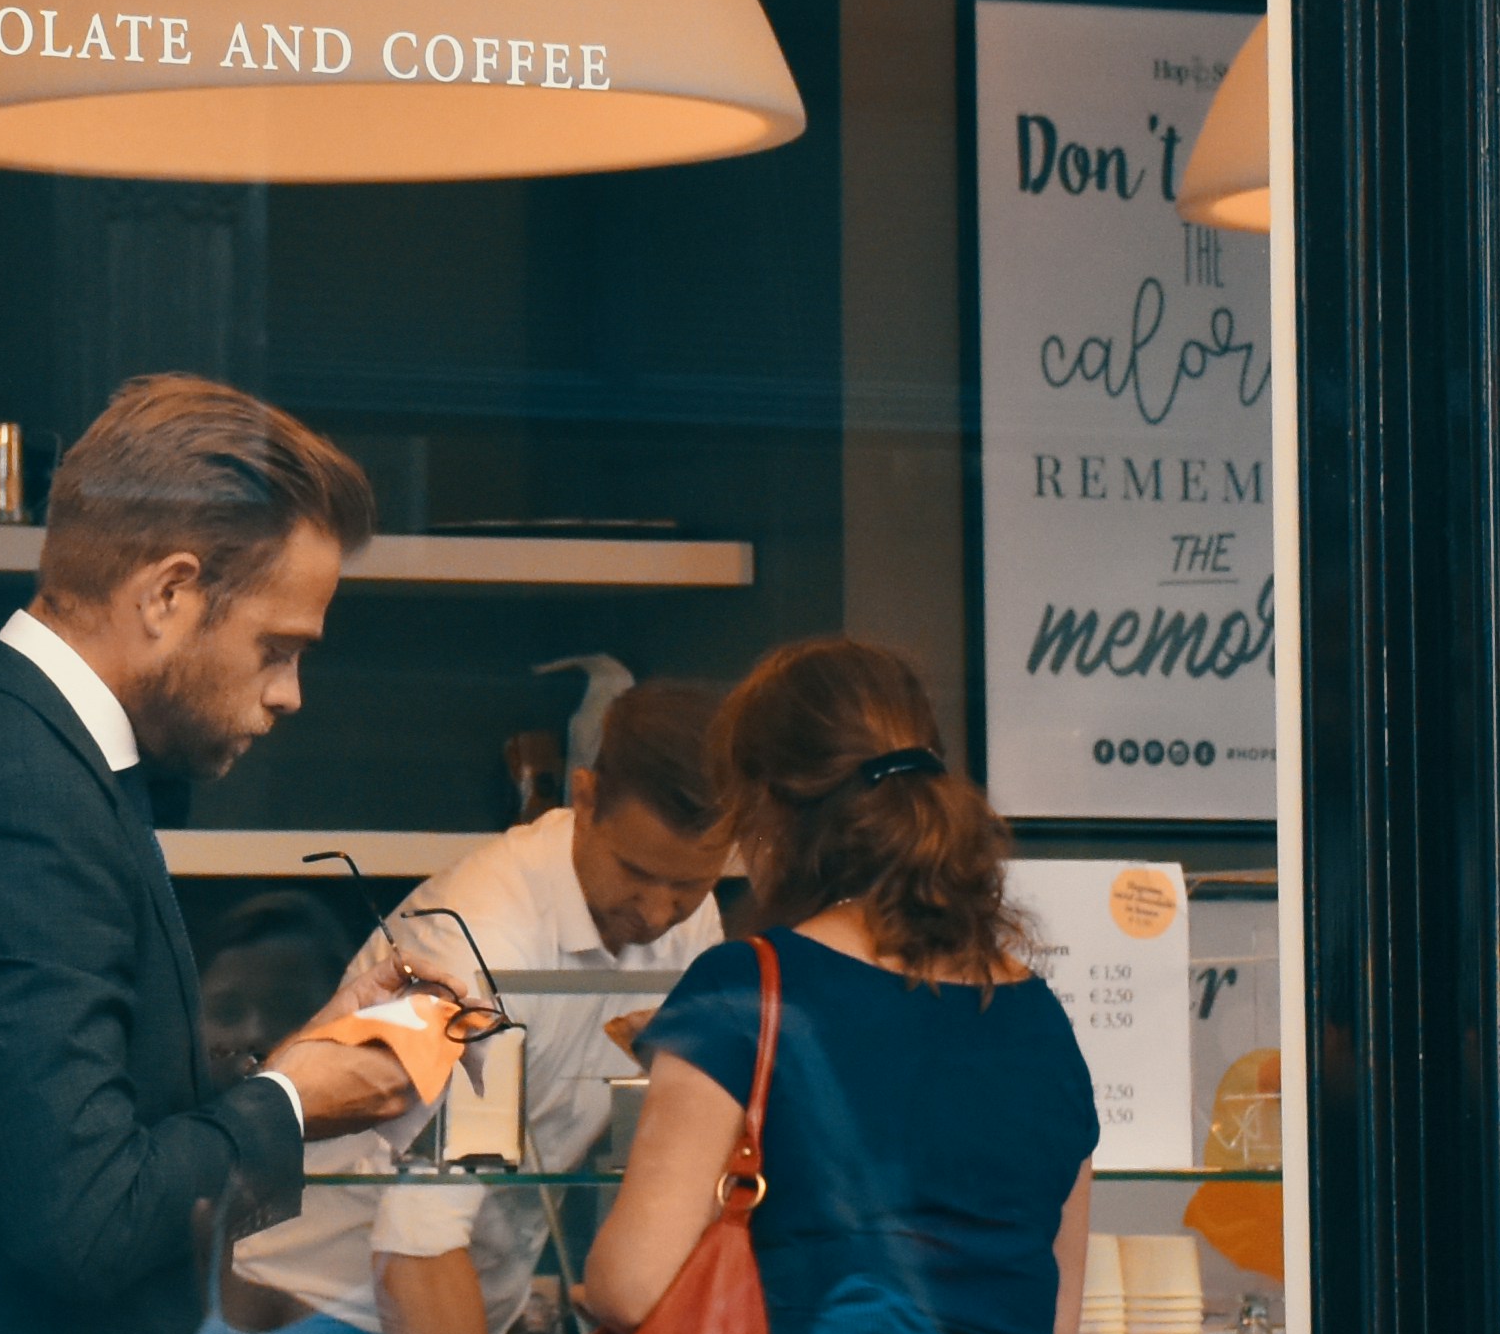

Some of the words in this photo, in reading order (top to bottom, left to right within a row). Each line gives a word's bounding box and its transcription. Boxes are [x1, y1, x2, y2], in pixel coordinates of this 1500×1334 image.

[220, 22, 353, 75] AND
[382, 32, 611, 90] COFFEE
[1016, 111, 1181, 203] Don't
[1041, 276, 1272, 425] calor
[1034, 453, 1264, 505] REMEM
[1172, 532, 1236, 572] THE
